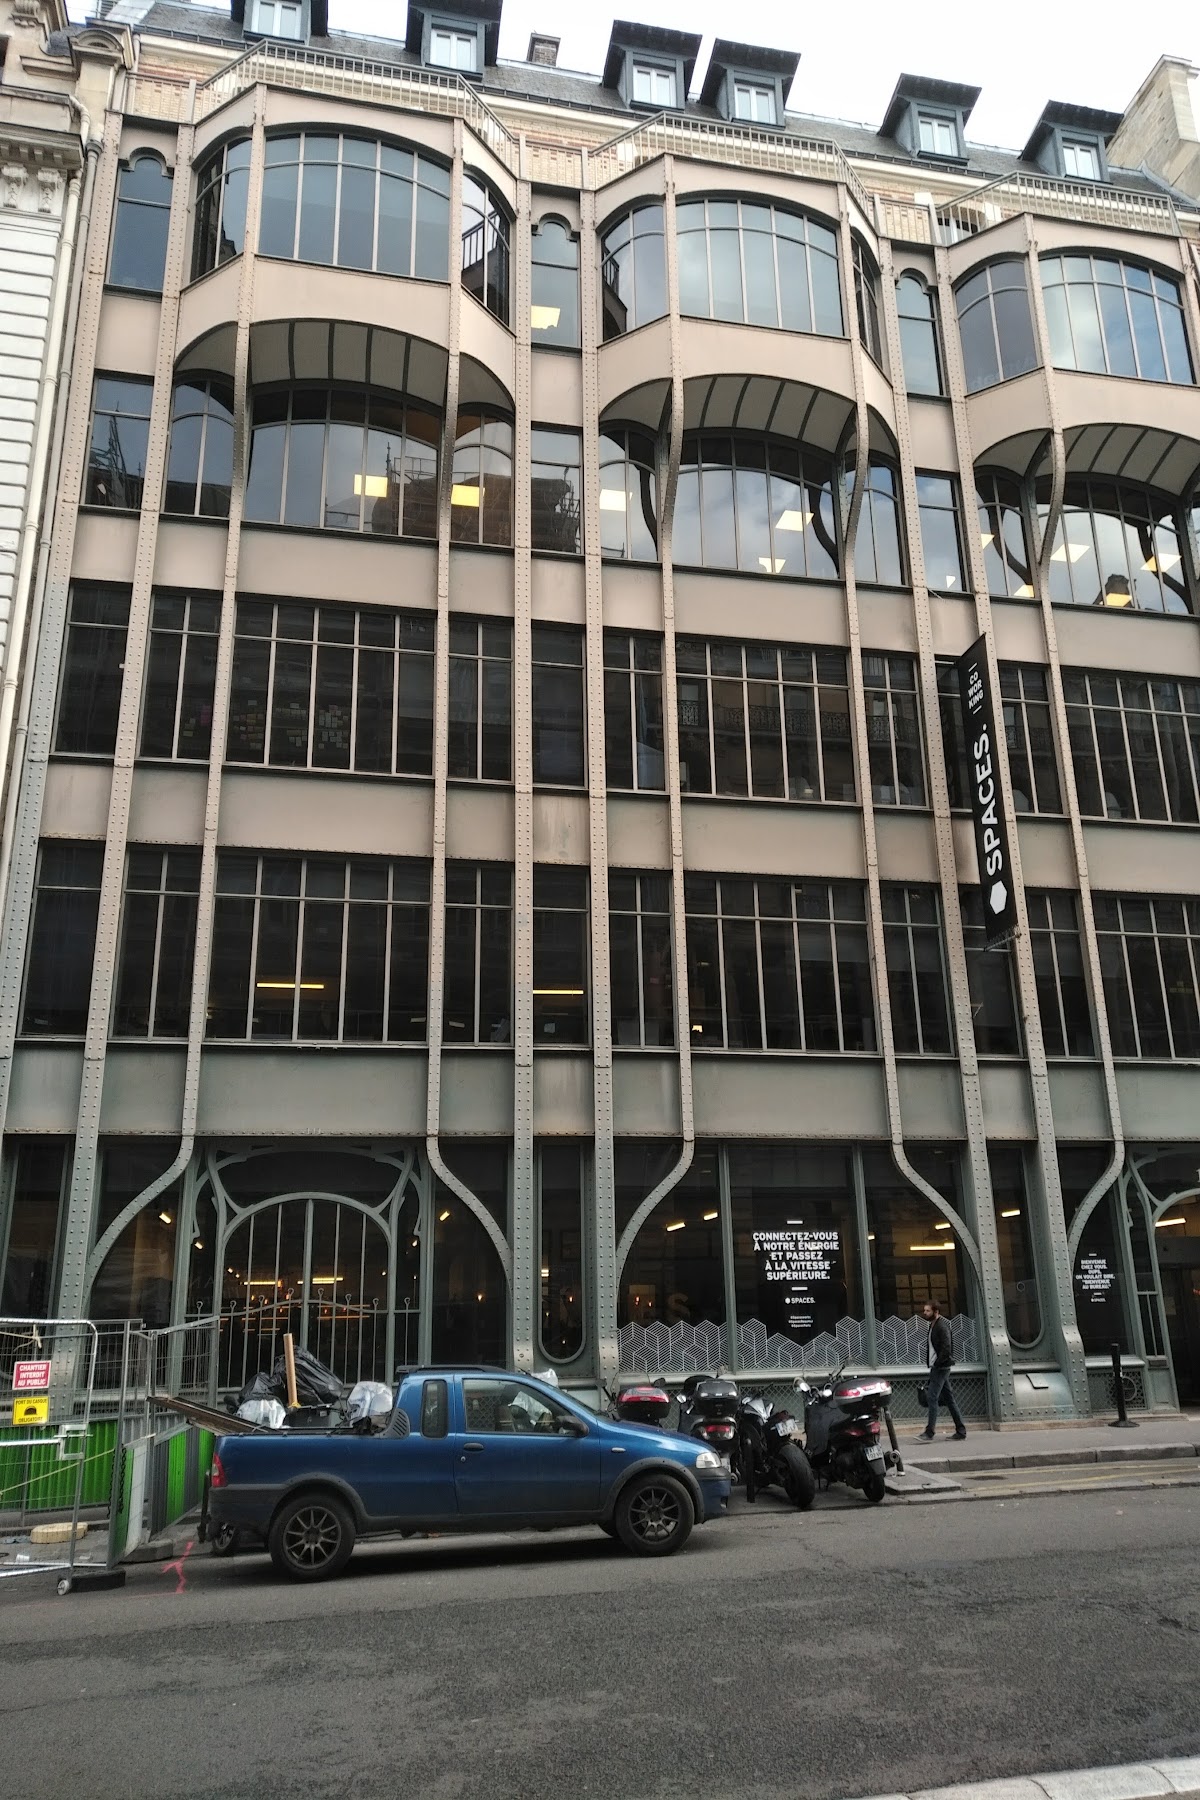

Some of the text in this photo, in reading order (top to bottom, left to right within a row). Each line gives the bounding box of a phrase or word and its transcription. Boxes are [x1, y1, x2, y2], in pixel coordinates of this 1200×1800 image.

[969, 671, 979, 685] CO
[968, 679, 982, 698] WOR
[968, 689, 984, 709] KING
[973, 723, 1003, 878] SPACES.
[753, 1232, 839, 1241] CONNECTEZ-VOUS
[753, 1240, 840, 1251] À NOTRE ÉNERGIE
[771, 1251, 823, 1261] ET PASSEZ
[765, 1260, 831, 1271] À LA VITESSE
[766, 1269, 831, 1281] SUPÉRIEURE.
[19, 1364, 47, 1372] CHANTIER
